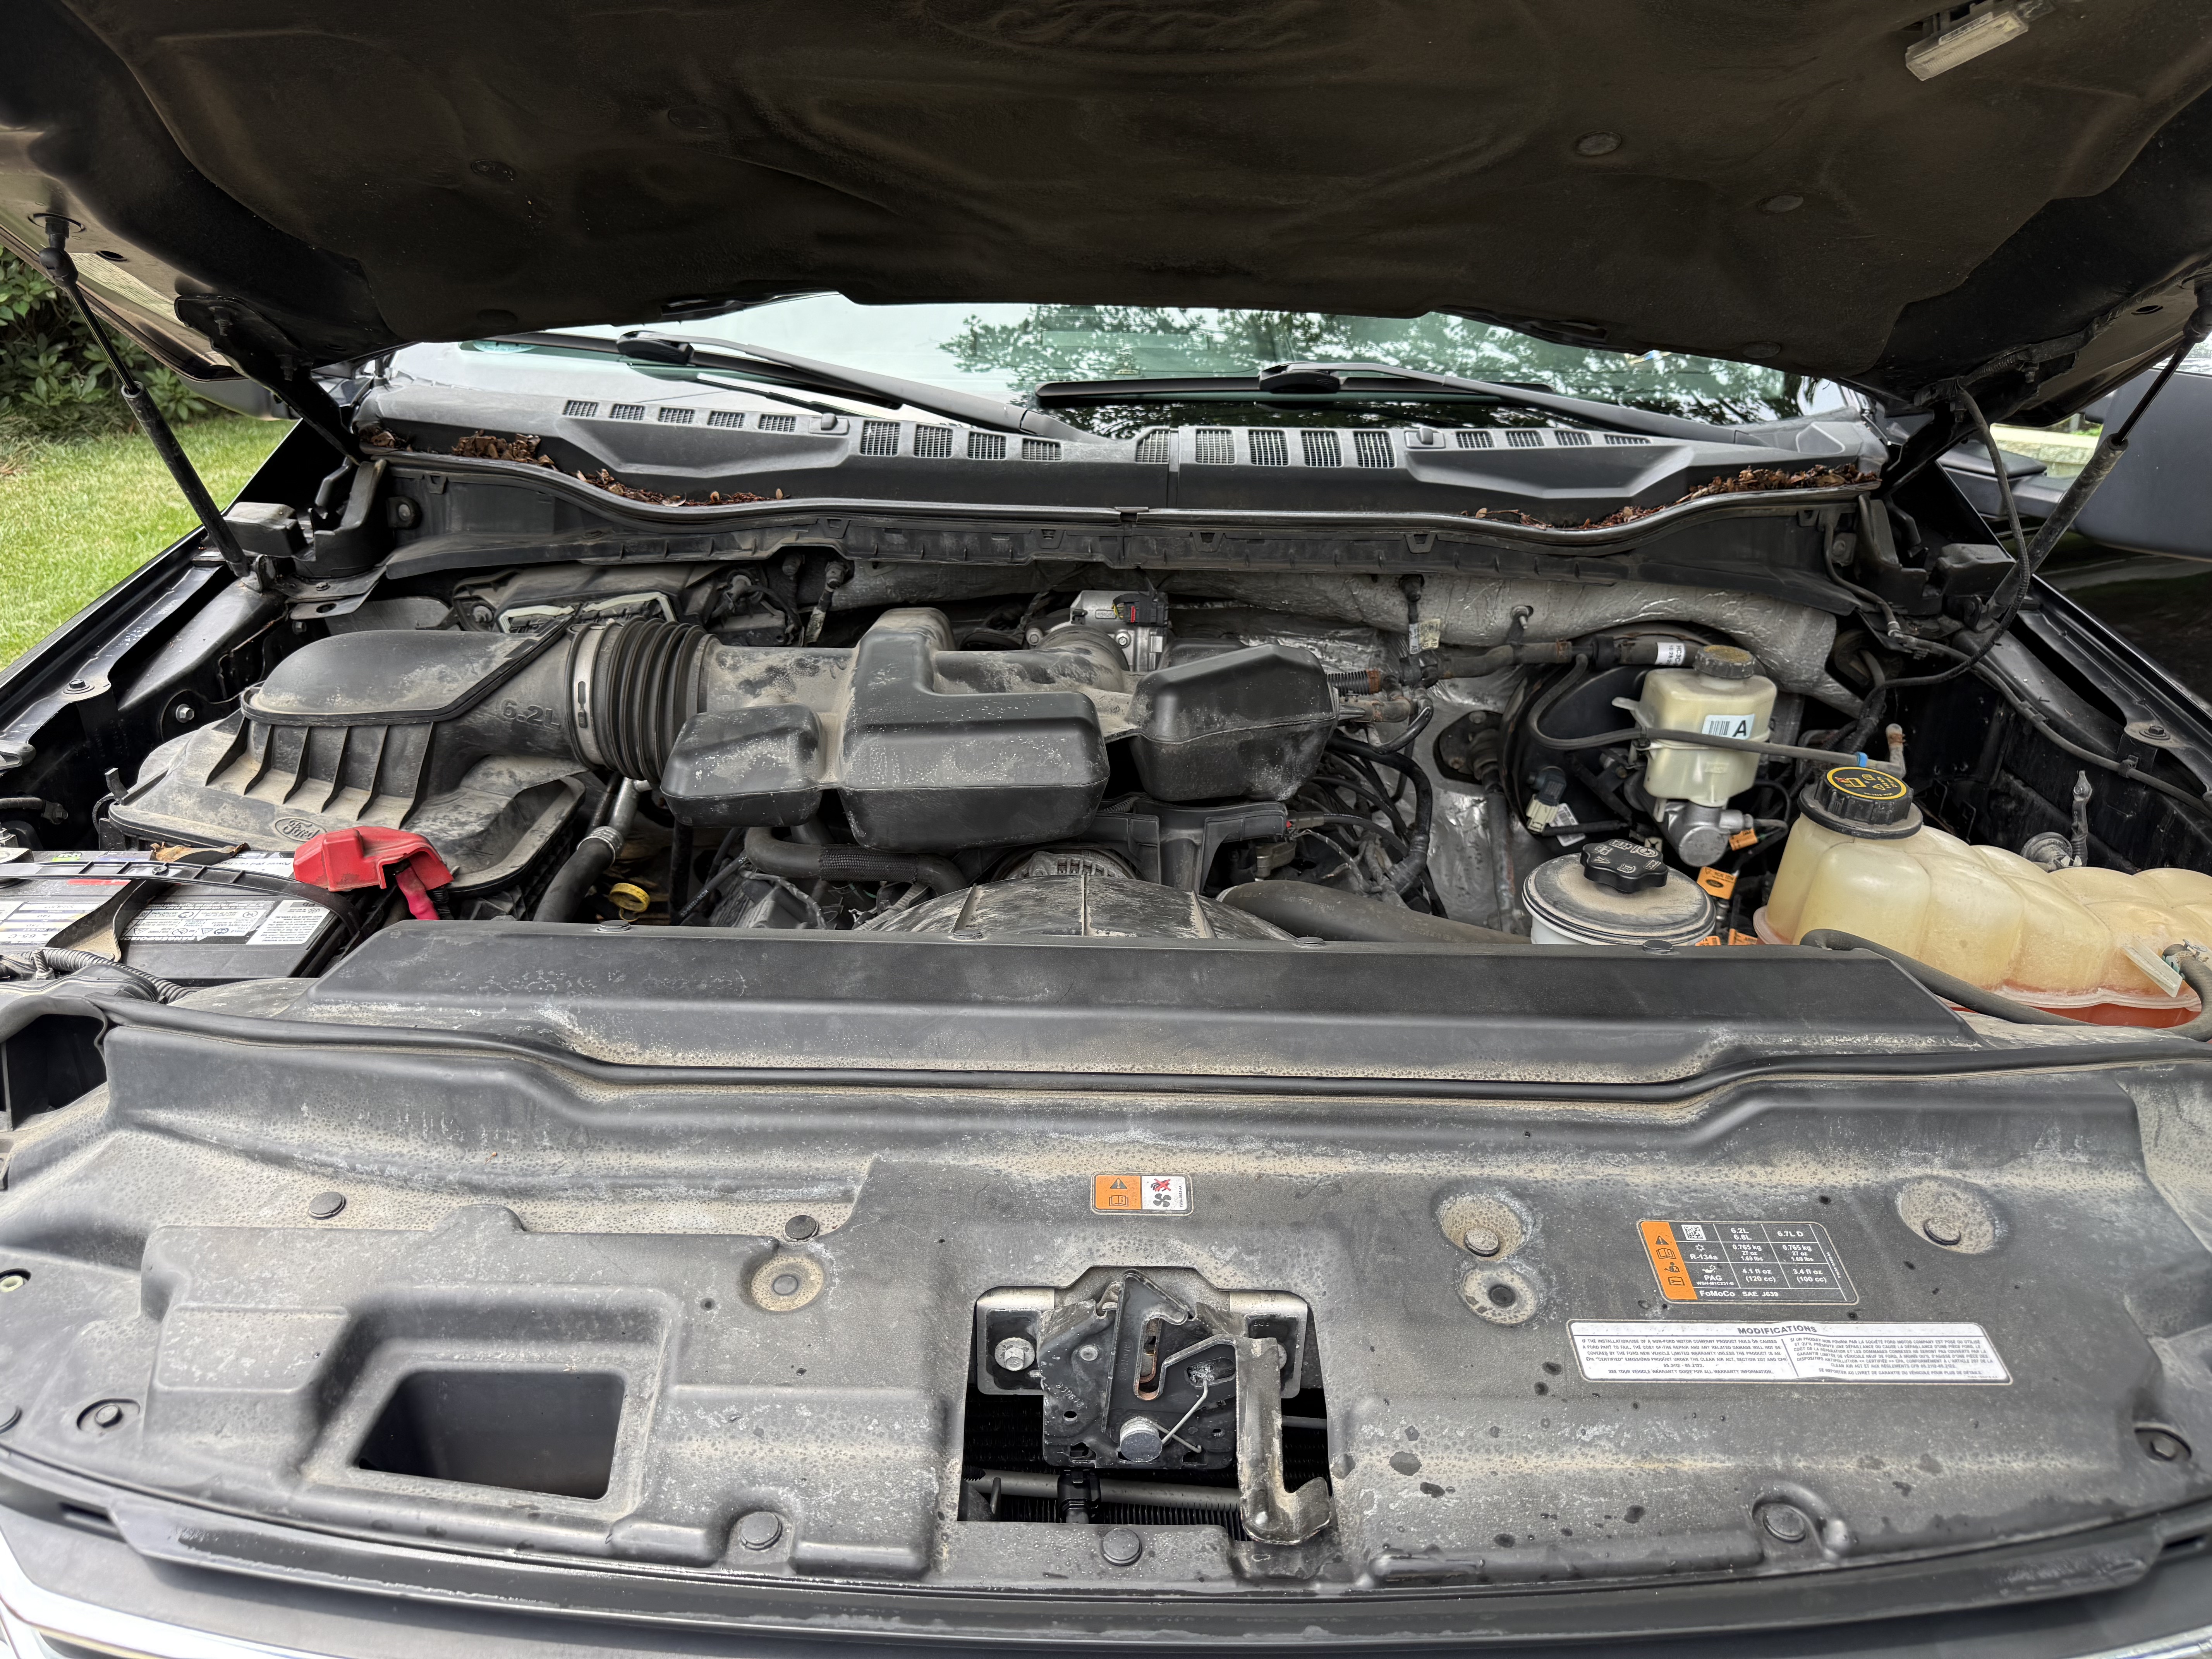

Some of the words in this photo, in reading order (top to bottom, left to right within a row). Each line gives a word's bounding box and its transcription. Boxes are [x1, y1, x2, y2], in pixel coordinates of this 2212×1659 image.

[501, 699, 561, 730] 6.2L
[1732, 720, 1746, 737] A
[283, 820, 320, 840] Ford
[1737, 1325, 1817, 1334] MODIFICATIONS
